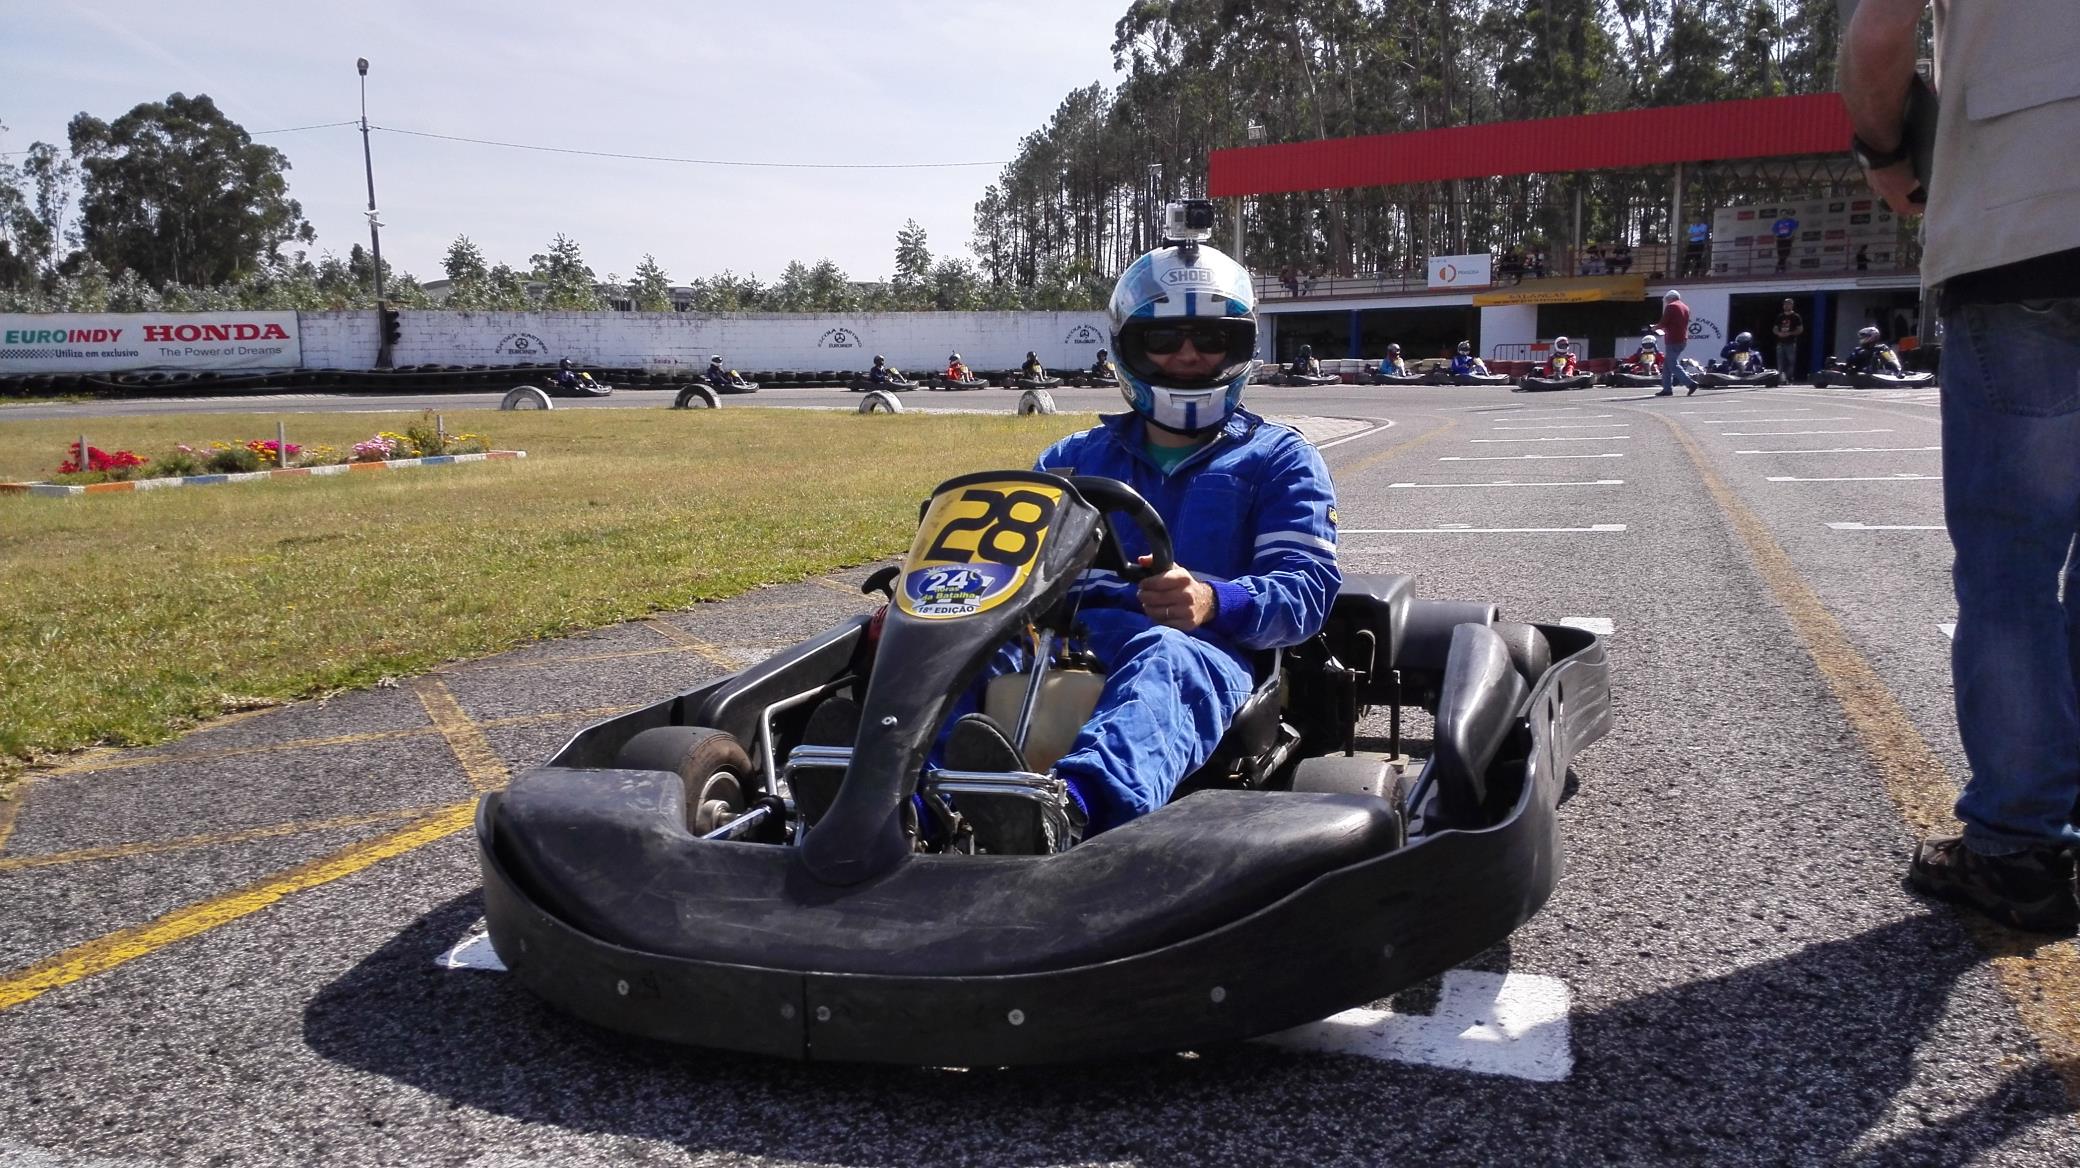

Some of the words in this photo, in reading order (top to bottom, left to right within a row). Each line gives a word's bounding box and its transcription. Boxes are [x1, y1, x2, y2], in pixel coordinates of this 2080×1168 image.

[1169, 269, 1212, 282] SHOEI
[5, 329, 122, 344] EUROINDY
[143, 324, 290, 342] HONDA
[55, 349, 86, 358] Utiliza
[101, 349, 139, 358] exclusivo
[159, 347, 181, 357] The
[184, 347, 219, 357] Power
[224, 346, 235, 356] of
[238, 345, 282, 356] Dreams
[924, 489, 1055, 567] 28
[926, 571, 969, 592] 24
[936, 591, 976, 600] Batalha
[935, 605, 974, 614] EDIÇÃO
